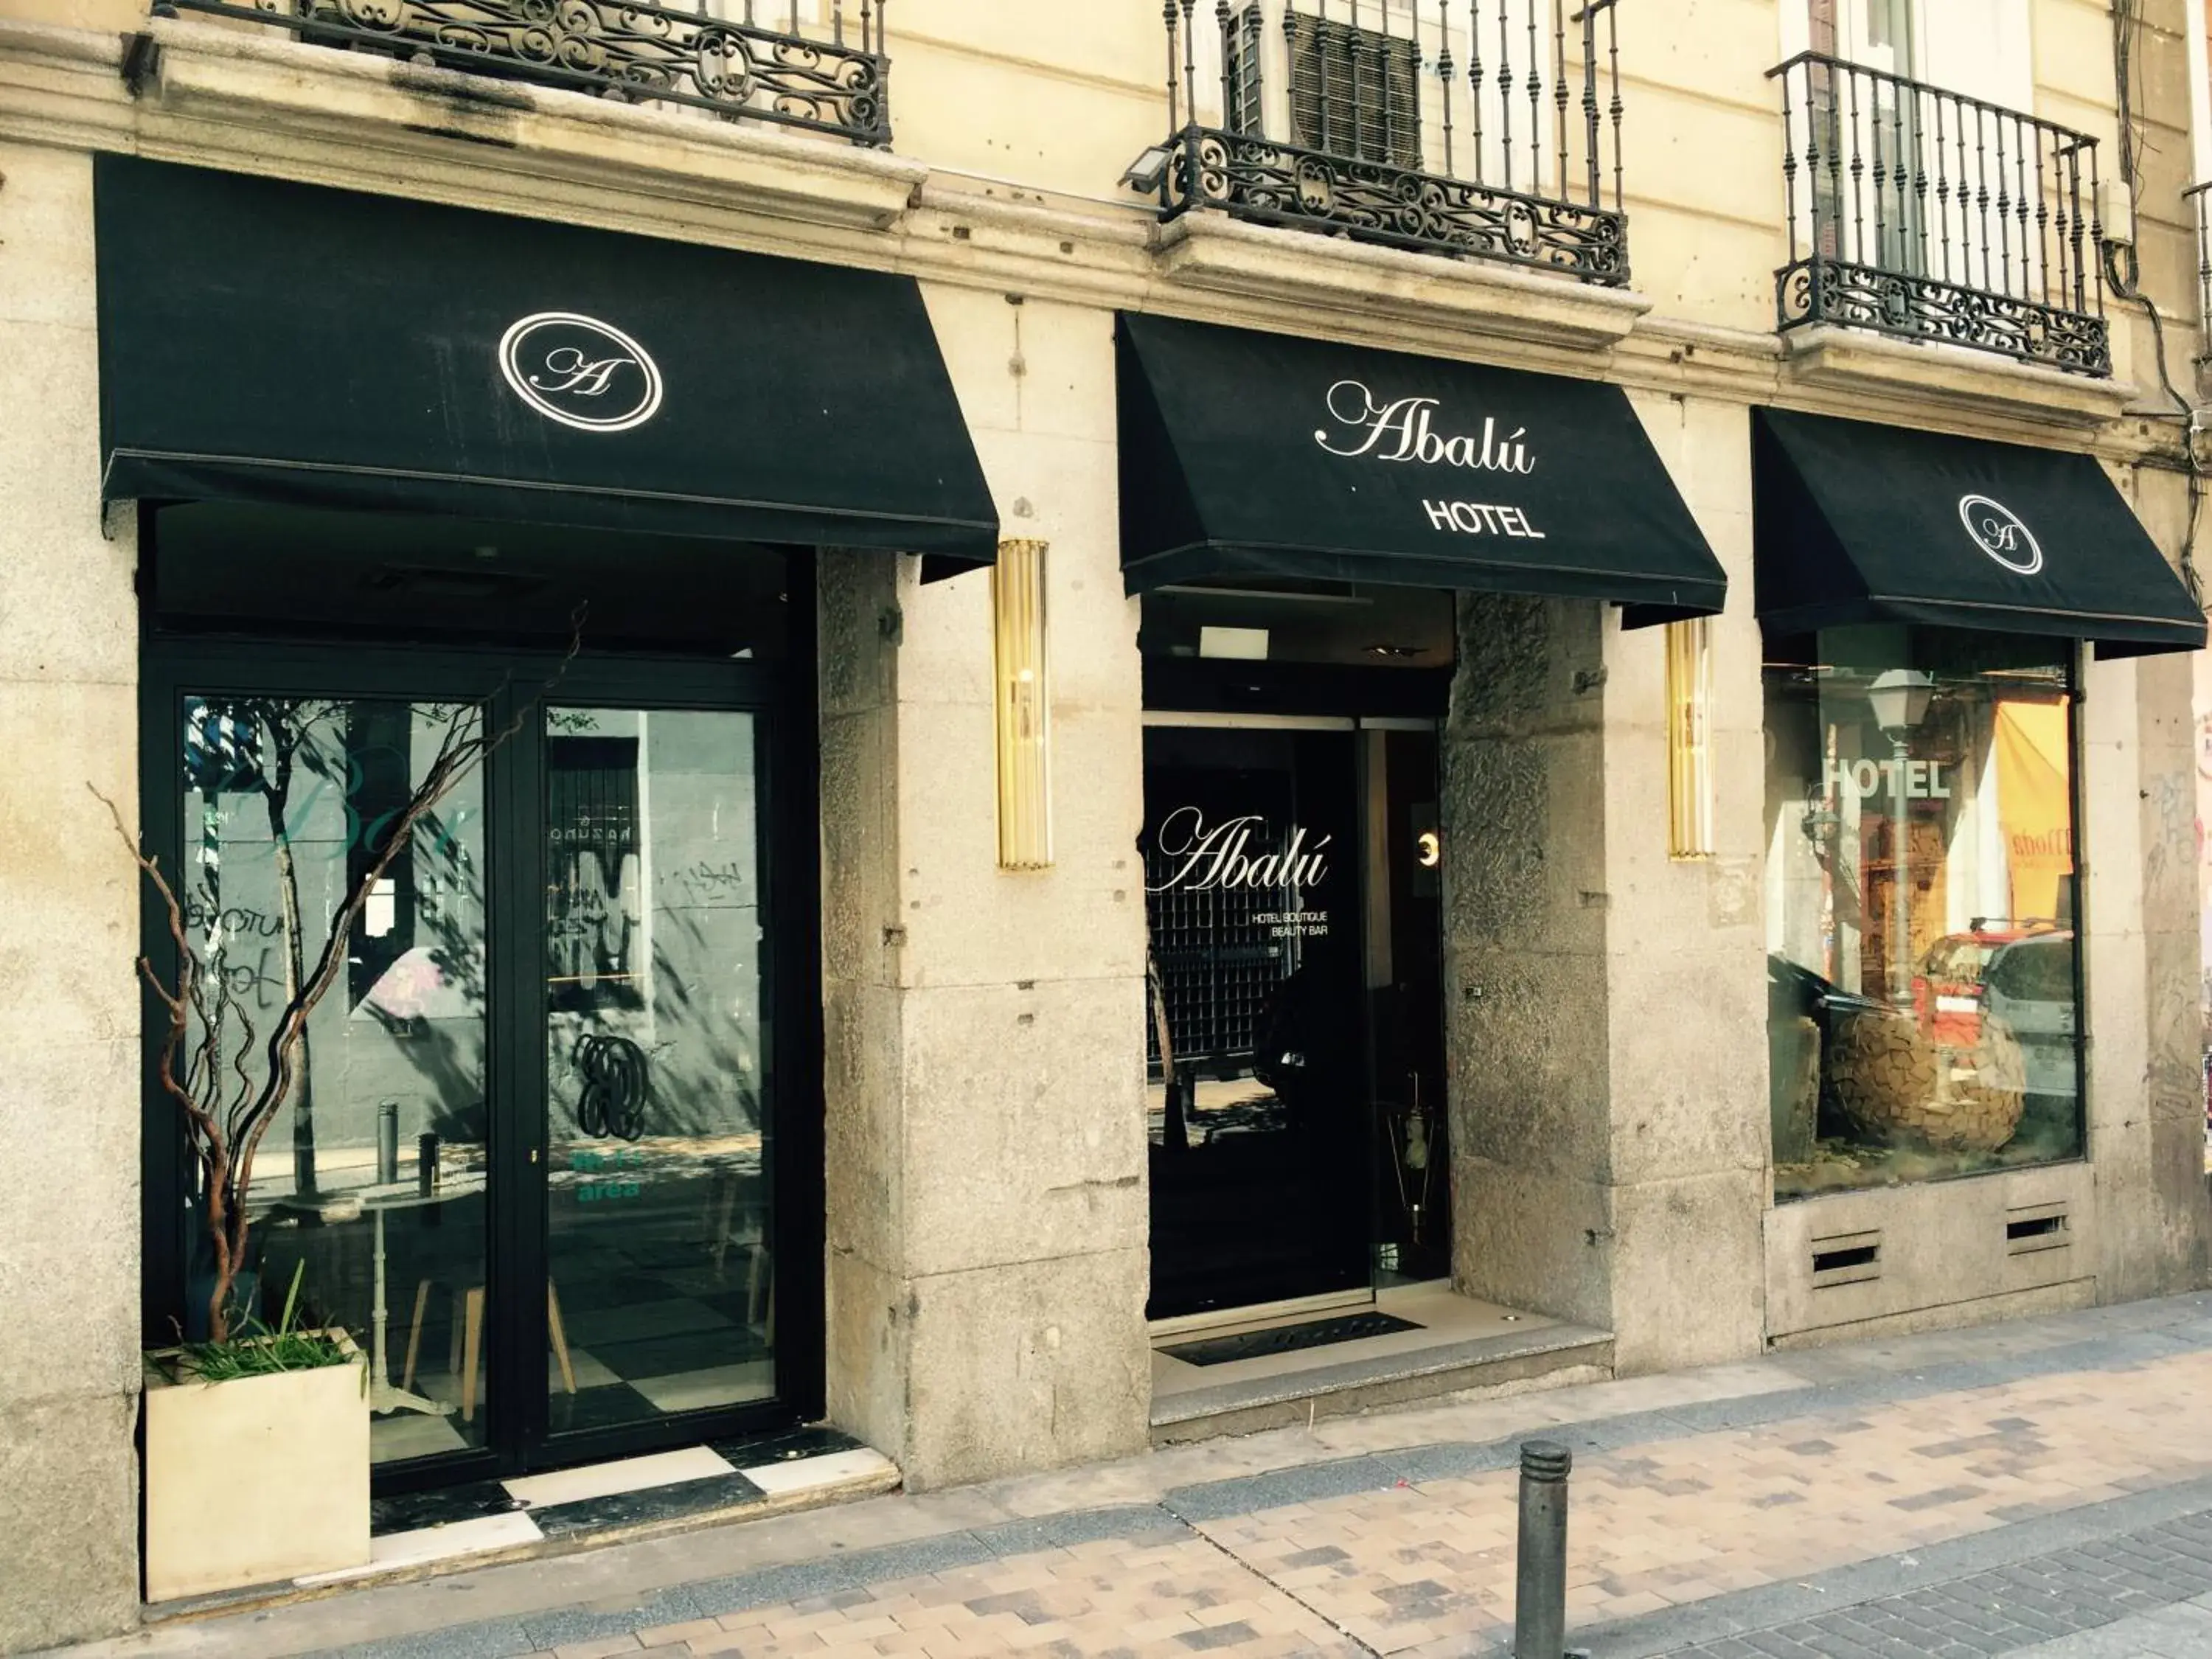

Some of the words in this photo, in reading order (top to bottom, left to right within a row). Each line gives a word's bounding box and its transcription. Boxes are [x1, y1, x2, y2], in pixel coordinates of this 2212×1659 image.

[529, 347, 636, 396] A
[1314, 380, 1536, 475] Abalú
[1422, 498, 1545, 539] HOTEL
[1823, 758, 1950, 799] HOTEL
[1145, 806, 1332, 892] Abalú
[1252, 914, 1281, 924] HOTEL
[1271, 927, 1307, 937] BEAUTY
[1309, 925, 1328, 935] BAR
[577, 1182, 640, 1203] area
